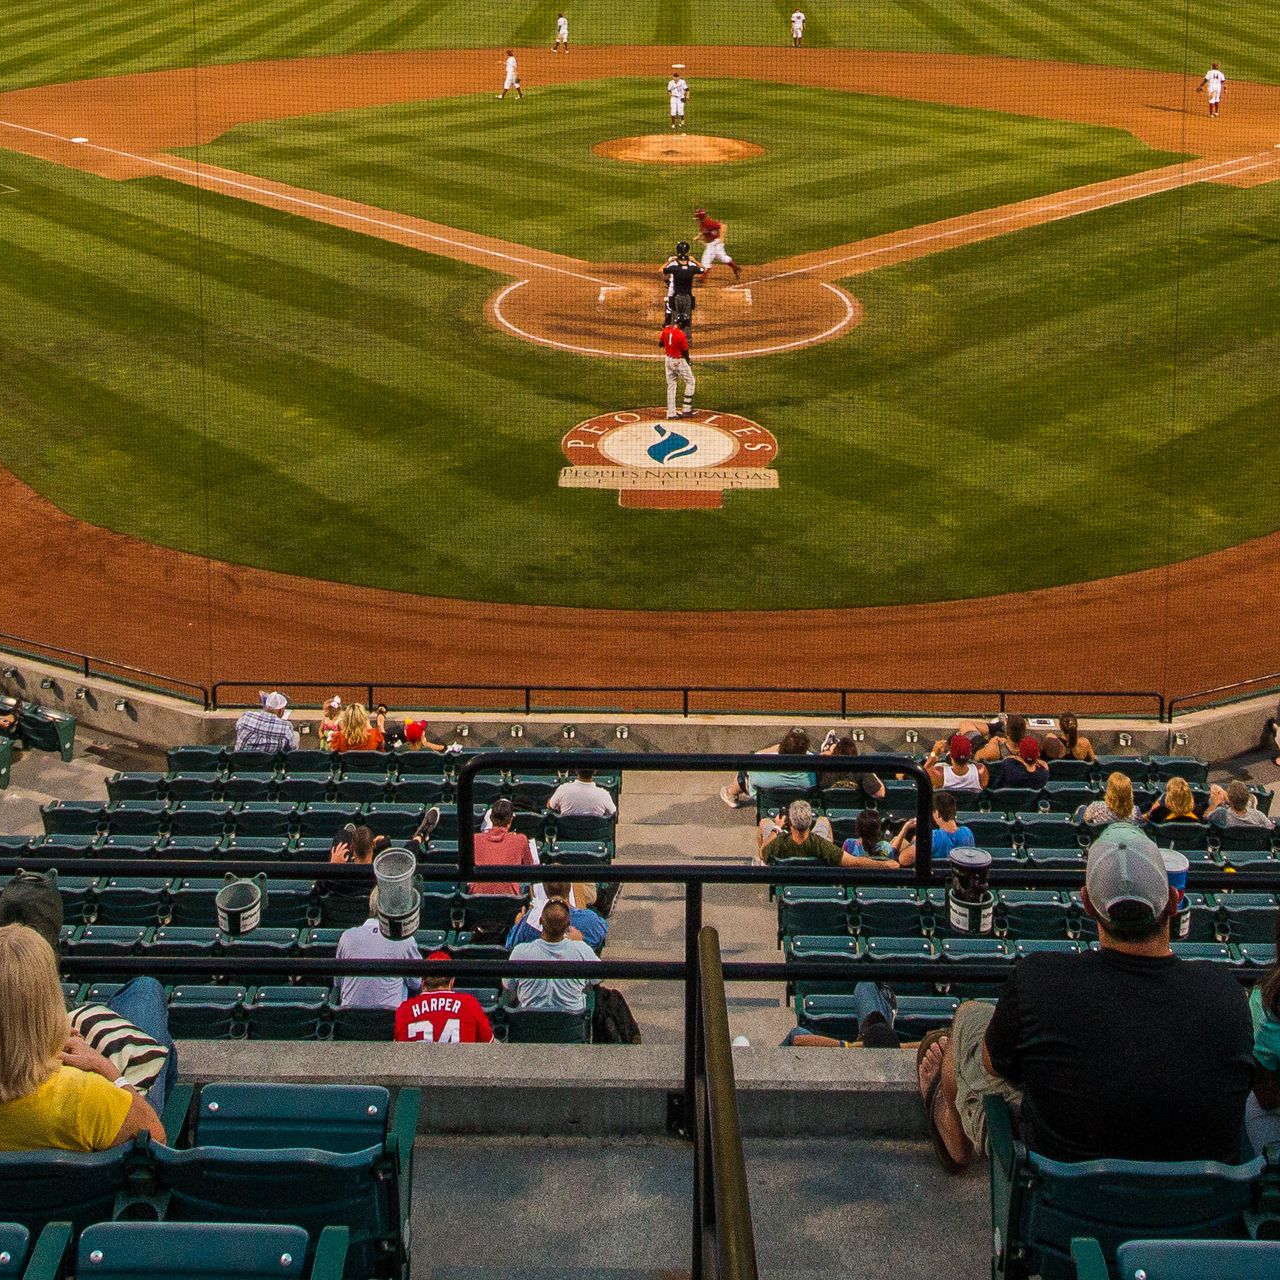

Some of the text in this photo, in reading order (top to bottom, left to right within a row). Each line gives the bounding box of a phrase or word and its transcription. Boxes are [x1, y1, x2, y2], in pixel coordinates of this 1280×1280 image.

[668, 333, 673, 346] 1
[562, 468, 773, 481] PEOPLES NATURAL GAS
[412, 998, 462, 1018] HARPER
